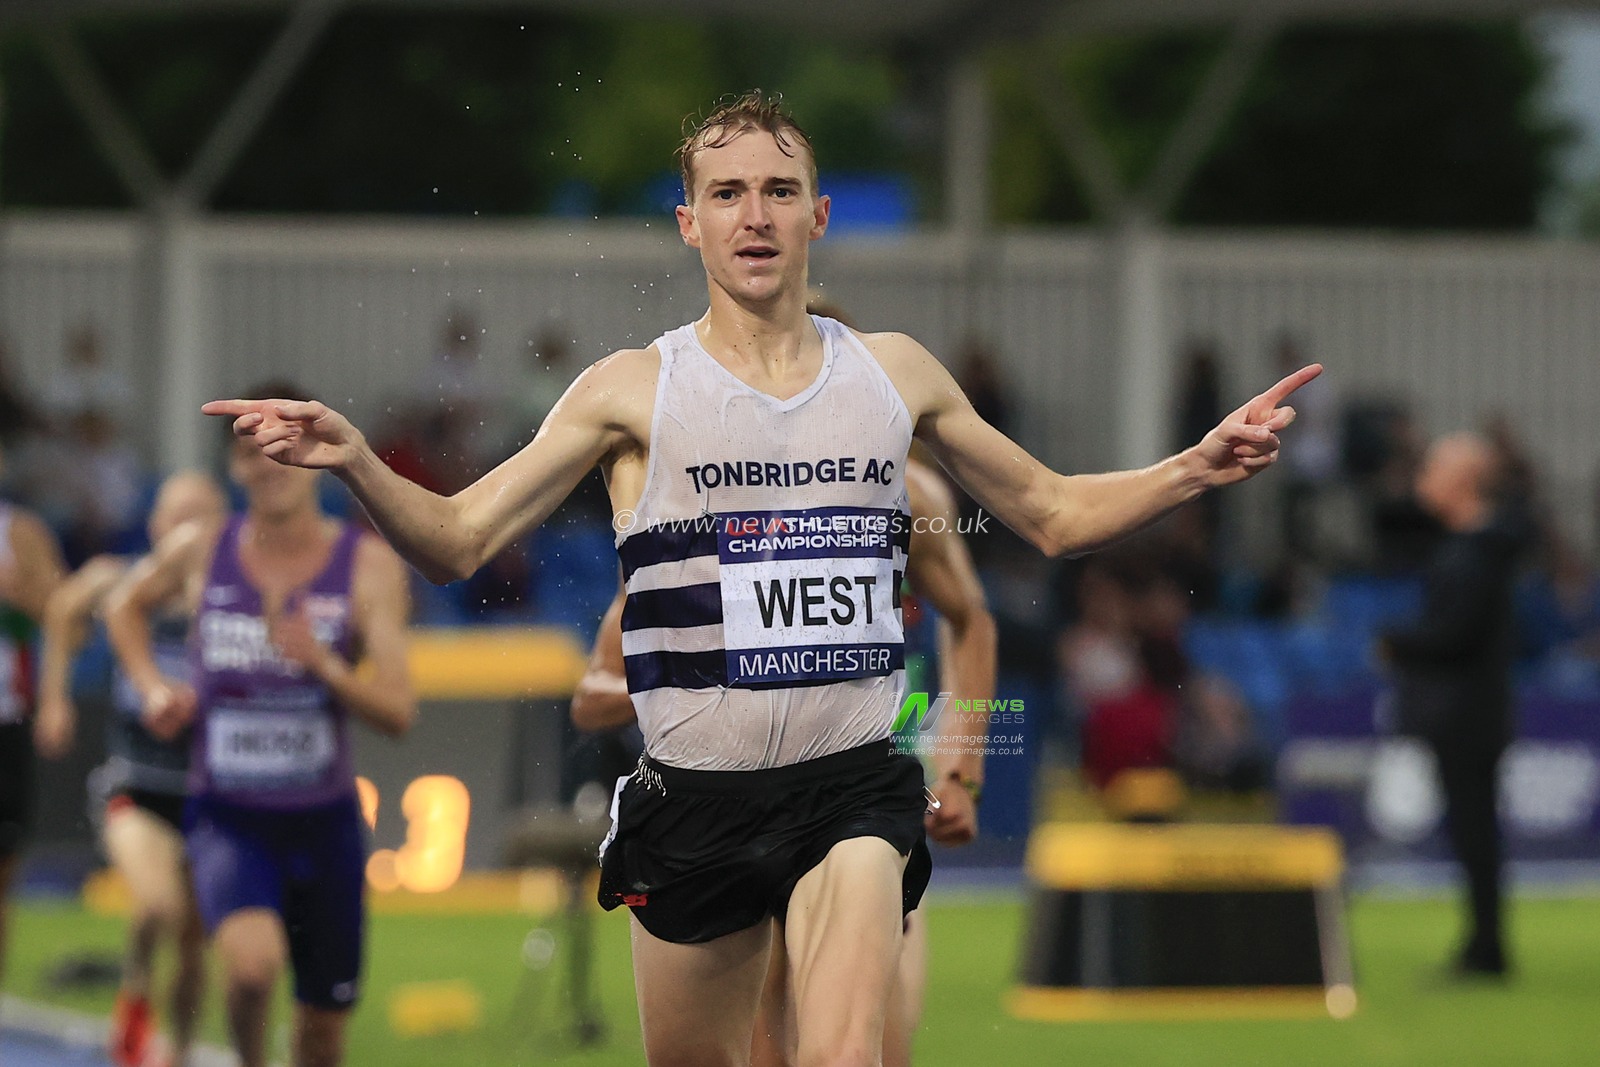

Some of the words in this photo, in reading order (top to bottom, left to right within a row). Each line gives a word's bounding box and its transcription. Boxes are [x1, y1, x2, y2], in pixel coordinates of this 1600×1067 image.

[685, 457, 856, 494] TONBRIDGE
[862, 458, 894, 486] AC
[728, 534, 888, 554] CHAMPIONSHIPS
[754, 576, 877, 629] WEST
[739, 649, 891, 677] MANCHESTER
